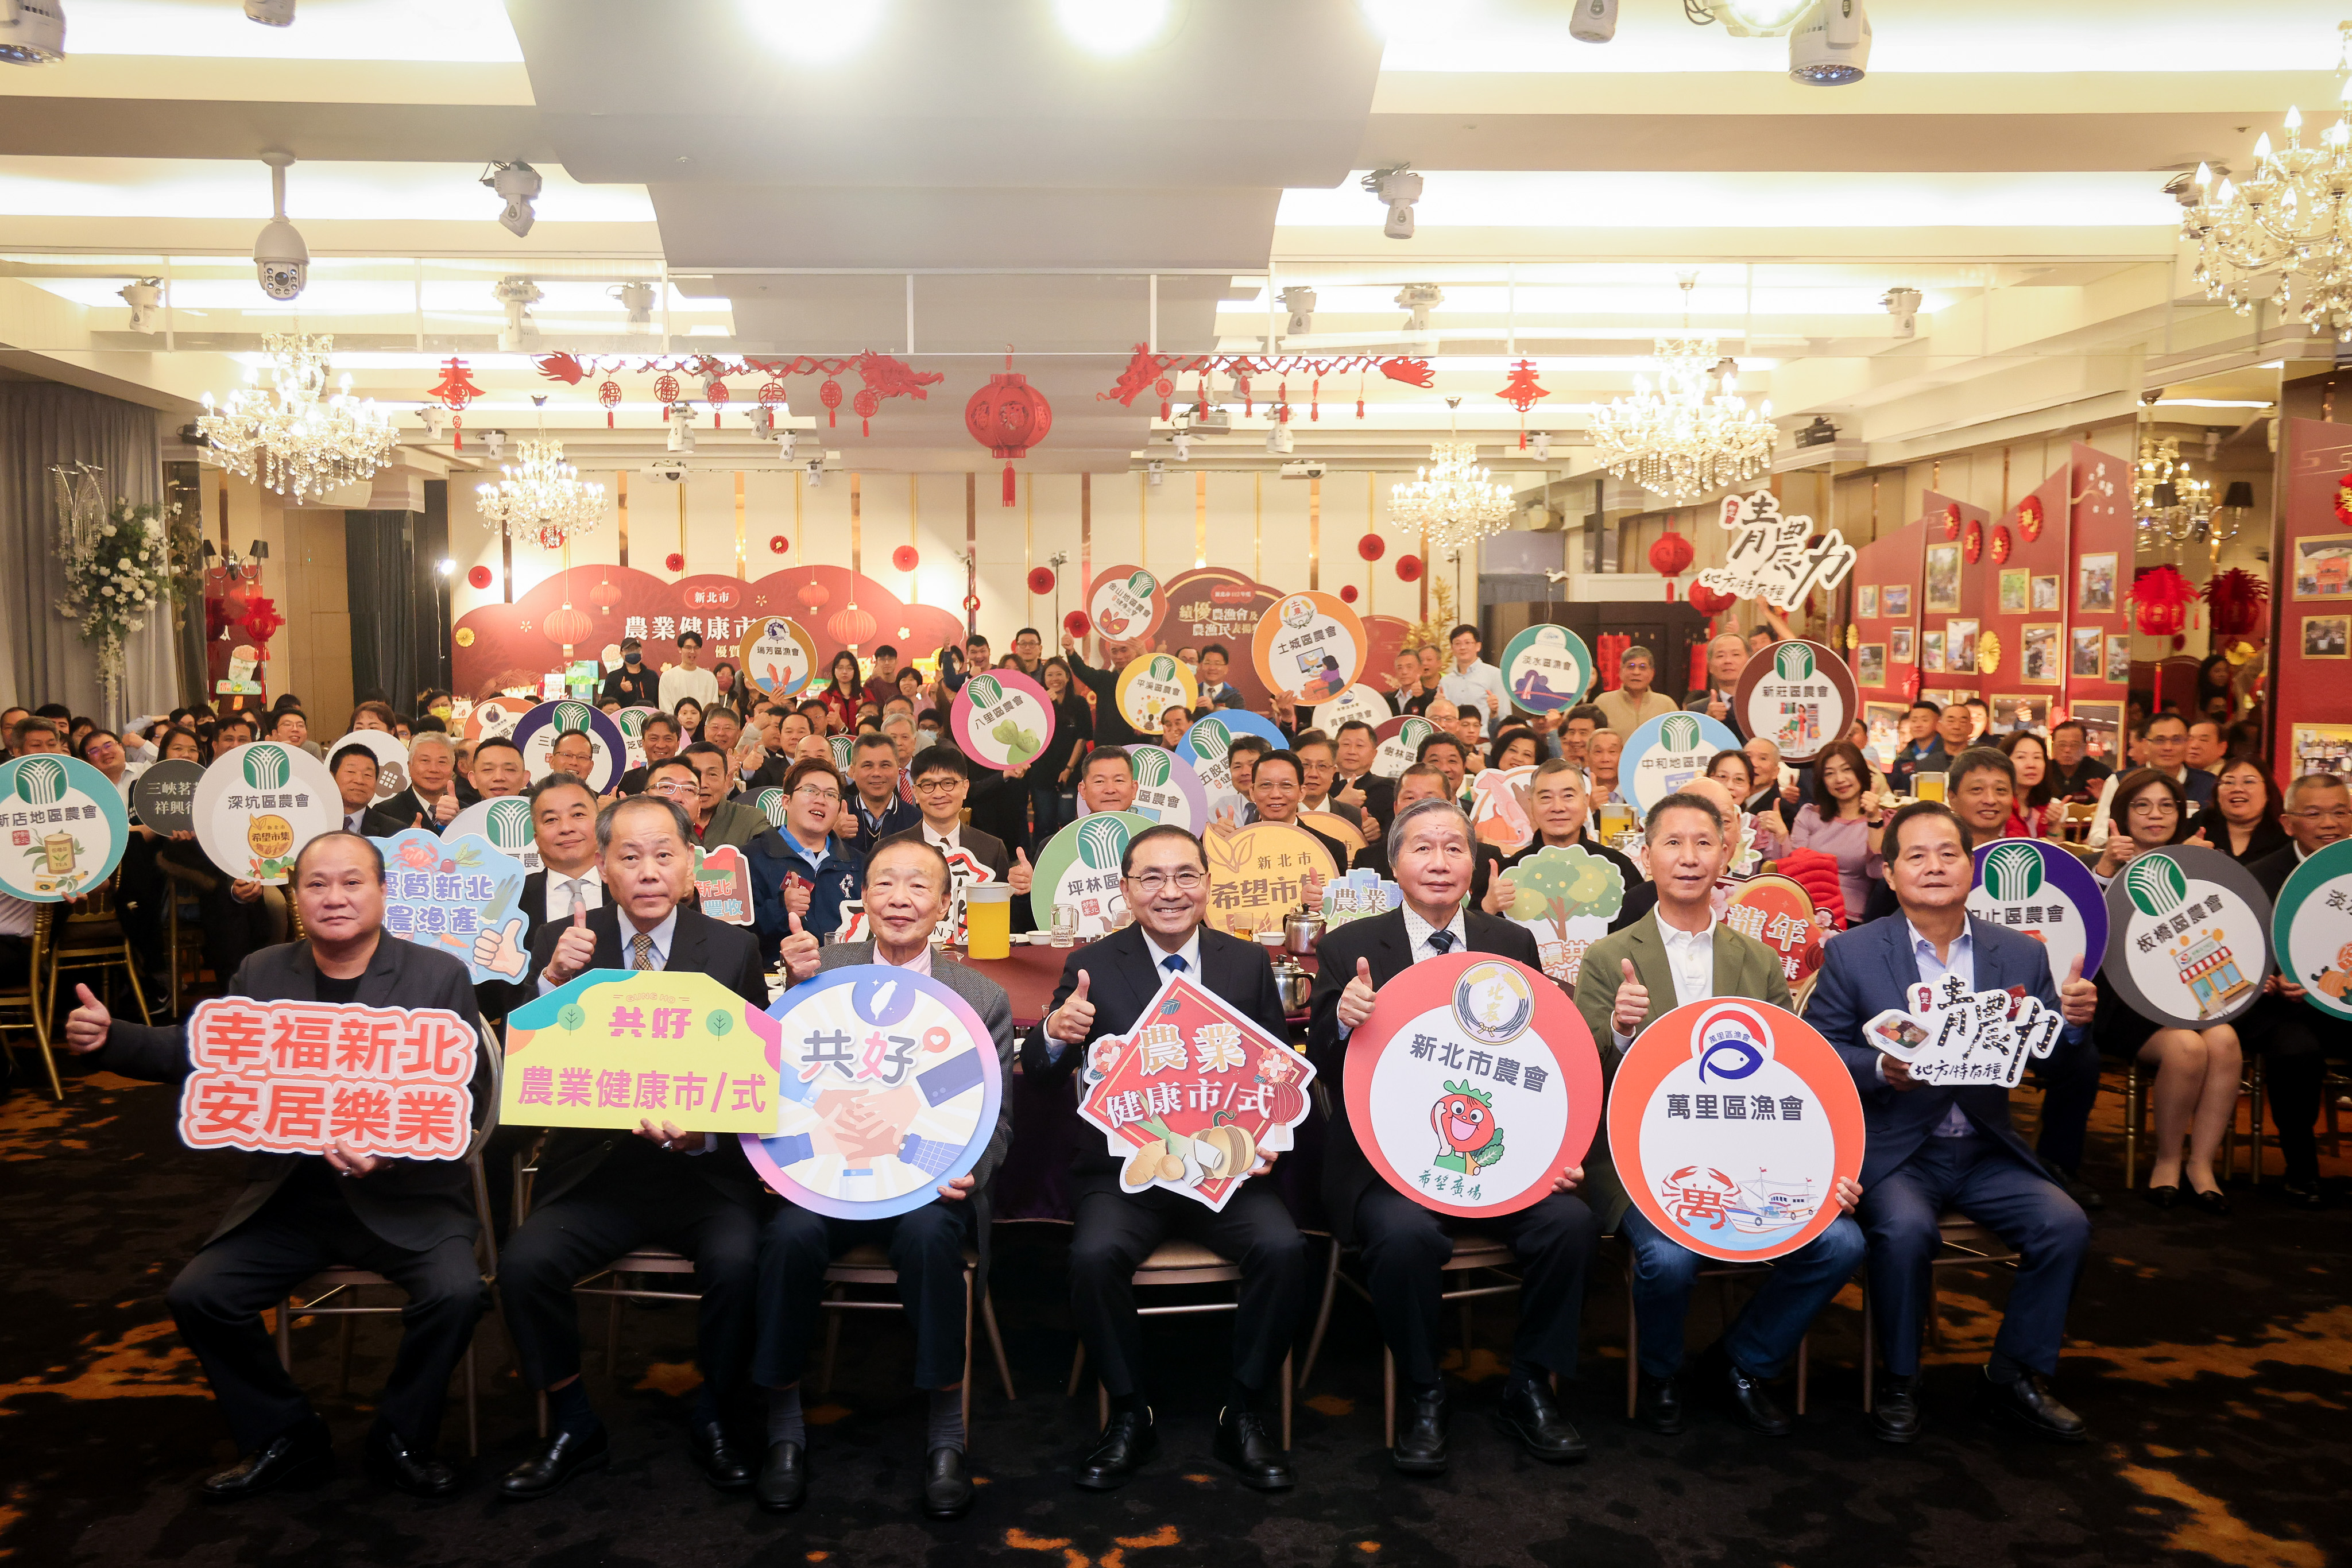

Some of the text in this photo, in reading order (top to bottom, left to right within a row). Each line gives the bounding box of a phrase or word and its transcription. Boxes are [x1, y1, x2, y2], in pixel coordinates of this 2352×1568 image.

[694, 591, 730, 603] 新北市
[624, 615, 757, 641] 農業健康市
[1278, 625, 1337, 655] 土城區農會
[757, 645, 799, 656] 瑞芳區漁會
[1137, 679, 1180, 696] 平溪區農會
[1762, 686, 1828, 698] 新莊區農會
[974, 695, 1024, 730] 八里區農會
[228, 793, 310, 810] 深坑區農會
[1139, 789, 1180, 808] 區農會
[0, 805, 96, 827] 新店地區農會
[252, 831, 290, 843] 希望市集
[1257, 851, 1312, 870] 新北市
[1067, 873, 1120, 896] 坪林區
[703, 899, 744, 917] 豐收
[1333, 888, 1390, 916] 農業
[386, 904, 478, 933] 農漁產
[2136, 895, 2224, 953] 板橋區農會
[626, 992, 676, 1004] GUNG HO
[608, 1006, 692, 1039] 共好
[206, 1012, 461, 1075] 幸福新北
[1140, 1023, 1245, 1076] 農業
[1708, 1030, 1751, 1044] 萬里區漁會
[801, 1029, 915, 1084] 共好
[1410, 1033, 1549, 1093] 新北市農會
[1915, 1060, 2002, 1082] 地方特有種
[517, 1066, 766, 1113] 農業健康市/式
[197, 1081, 457, 1144] 安居樂業
[1106, 1078, 1274, 1129] 健康市/式
[1667, 1094, 1804, 1120] 萬里區漁會
[1418, 1168, 1481, 1201] 希望廣場
